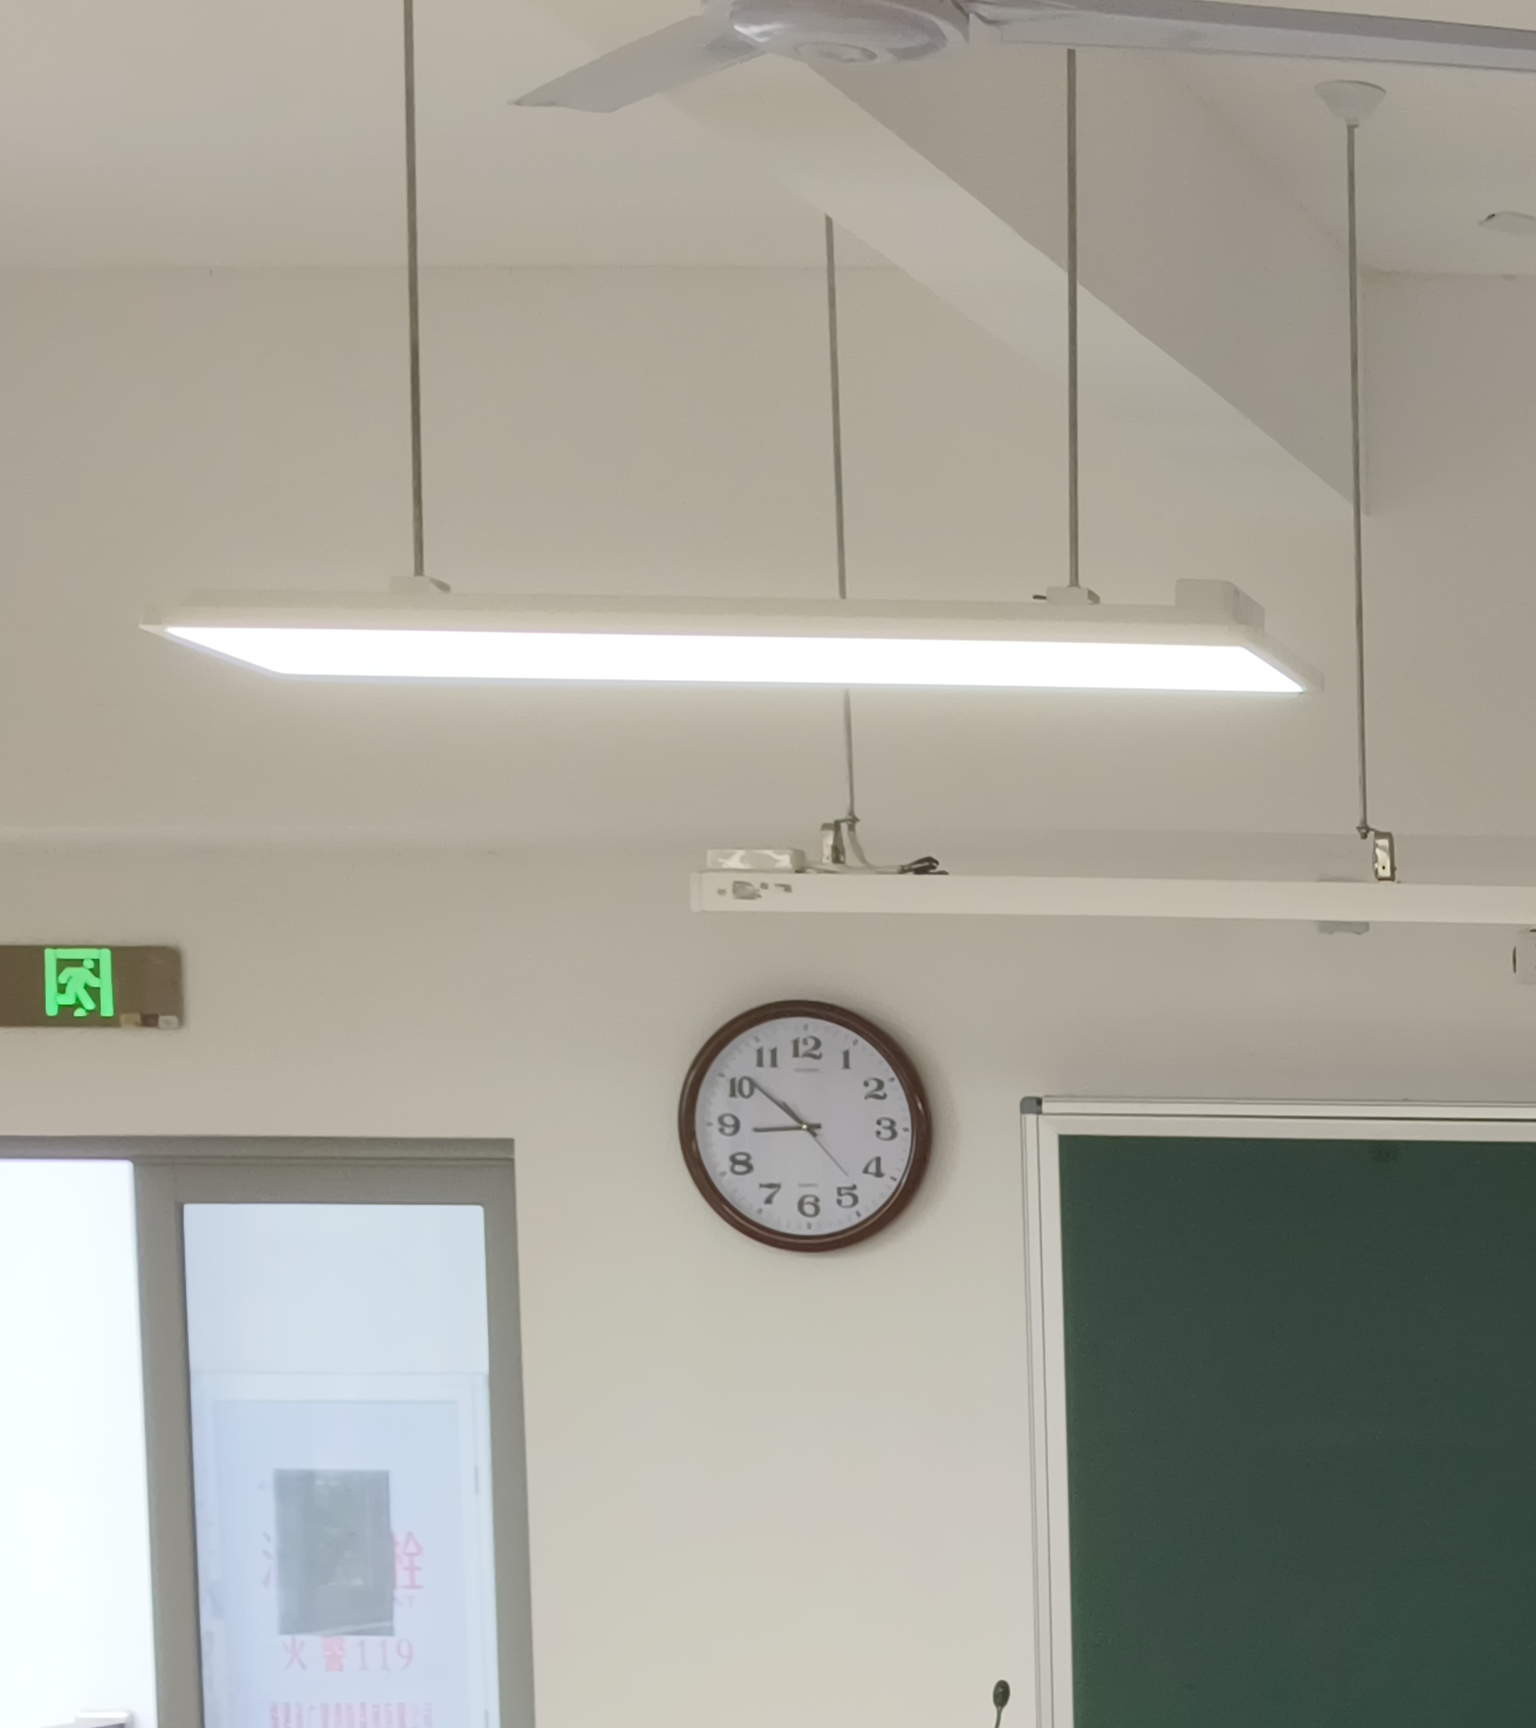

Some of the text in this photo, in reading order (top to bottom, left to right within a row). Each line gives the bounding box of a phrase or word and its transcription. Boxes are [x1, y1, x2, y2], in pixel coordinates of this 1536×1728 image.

[755, 1046, 779, 1069] 11
[791, 1035, 823, 1060] 12
[841, 1049, 852, 1070] 1
[728, 1076, 755, 1099] 10
[863, 1077, 888, 1100] 2
[717, 1113, 741, 1137] 9
[875, 1117, 898, 1141] 3
[729, 1151, 754, 1176] 8
[862, 1156, 886, 1178] 4
[758, 1182, 782, 1205] 7
[836, 1184, 859, 1208] 5
[797, 1194, 821, 1218] 6
